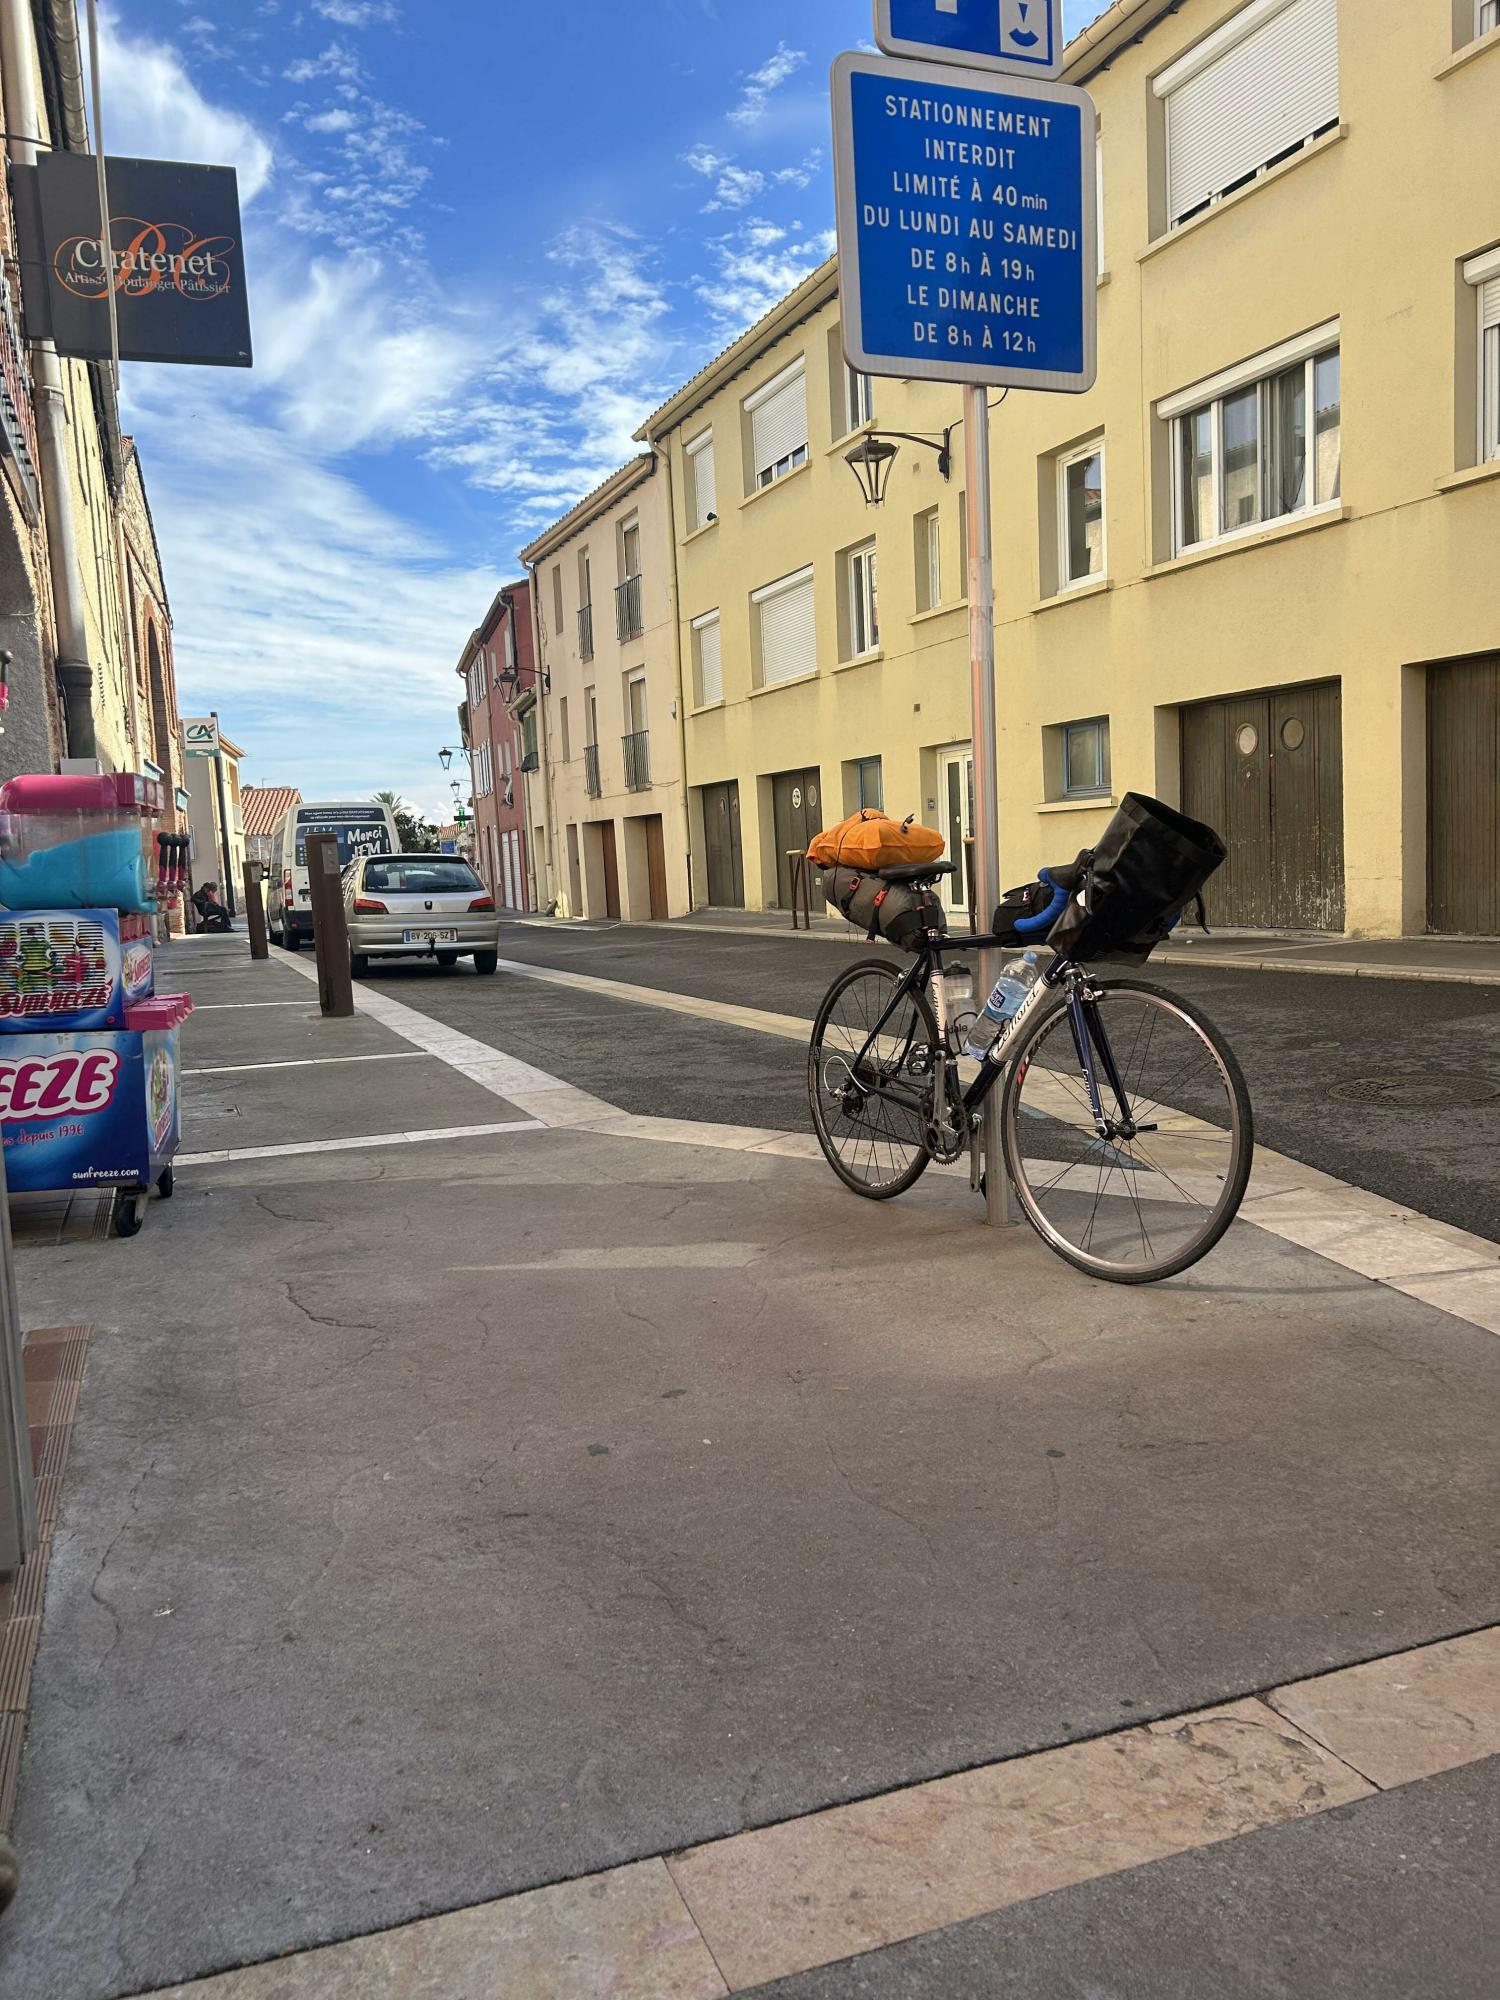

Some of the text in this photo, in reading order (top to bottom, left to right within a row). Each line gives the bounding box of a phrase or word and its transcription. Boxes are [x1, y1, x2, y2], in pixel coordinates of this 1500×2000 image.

[885, 95, 1051, 138] STATIONNEMENT
[925, 138, 1016, 170] INTERDIT
[893, 171, 961, 199] LIMITÉ
[970, 177, 982, 202] À
[864, 205, 1077, 251] DU LUNDI AU SAMEDI
[74, 239, 217, 276] Chatenet
[911, 247, 936, 270] DE
[980, 252, 991, 277] À
[180, 279, 231, 294] Pâtissier
[907, 284, 1040, 318] LE DIMANCHE
[914, 321, 938, 344] DE
[982, 325, 993, 349] À
[347, 826, 382, 844] Merci
[18, 1128, 55, 1146] depuis
[72, 1166, 140, 1180] sunfreeze.com
